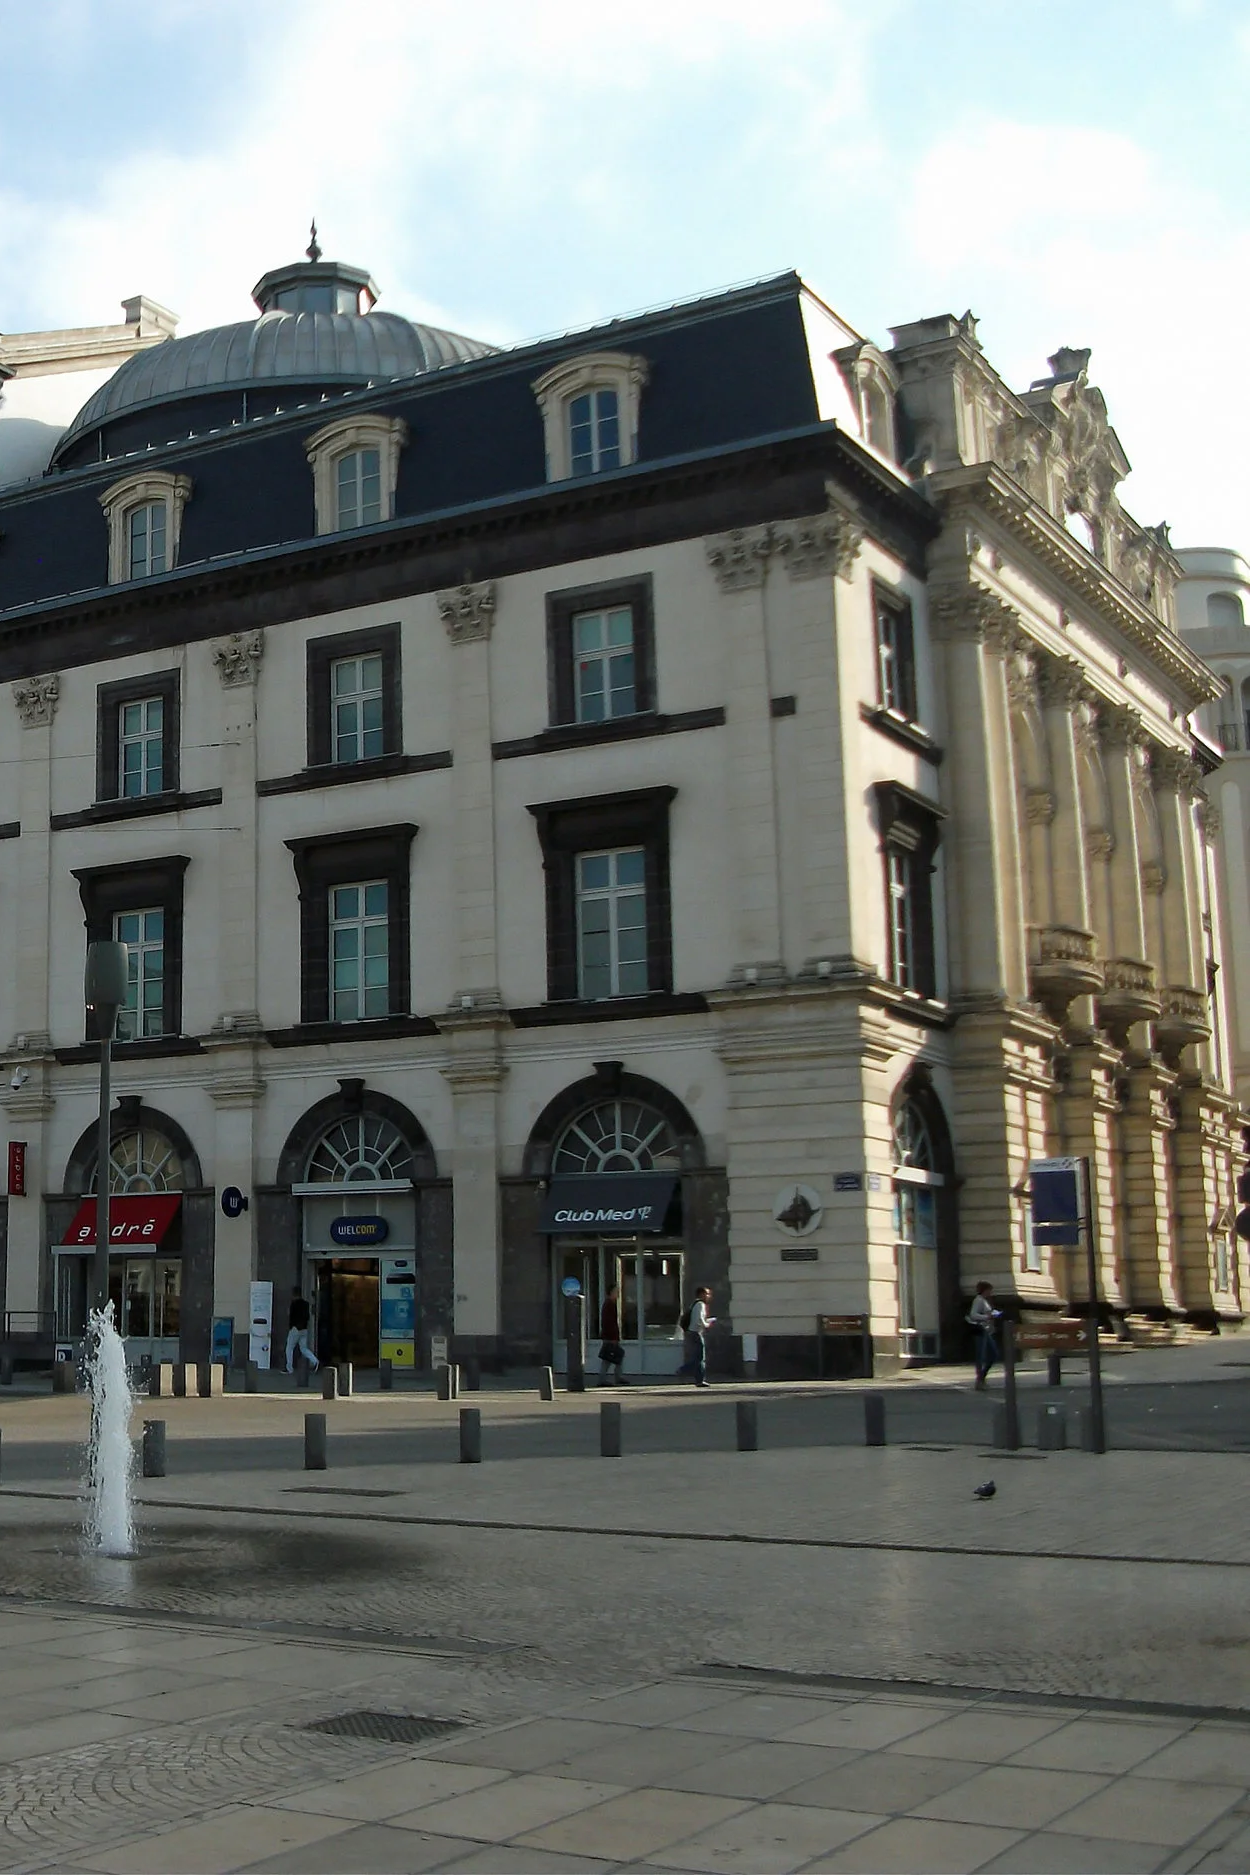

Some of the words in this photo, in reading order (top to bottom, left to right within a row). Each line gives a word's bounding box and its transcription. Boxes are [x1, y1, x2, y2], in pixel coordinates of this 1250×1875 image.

[554, 1209, 594, 1222] Club
[595, 1207, 635, 1221] Med
[77, 1219, 156, 1242] adré
